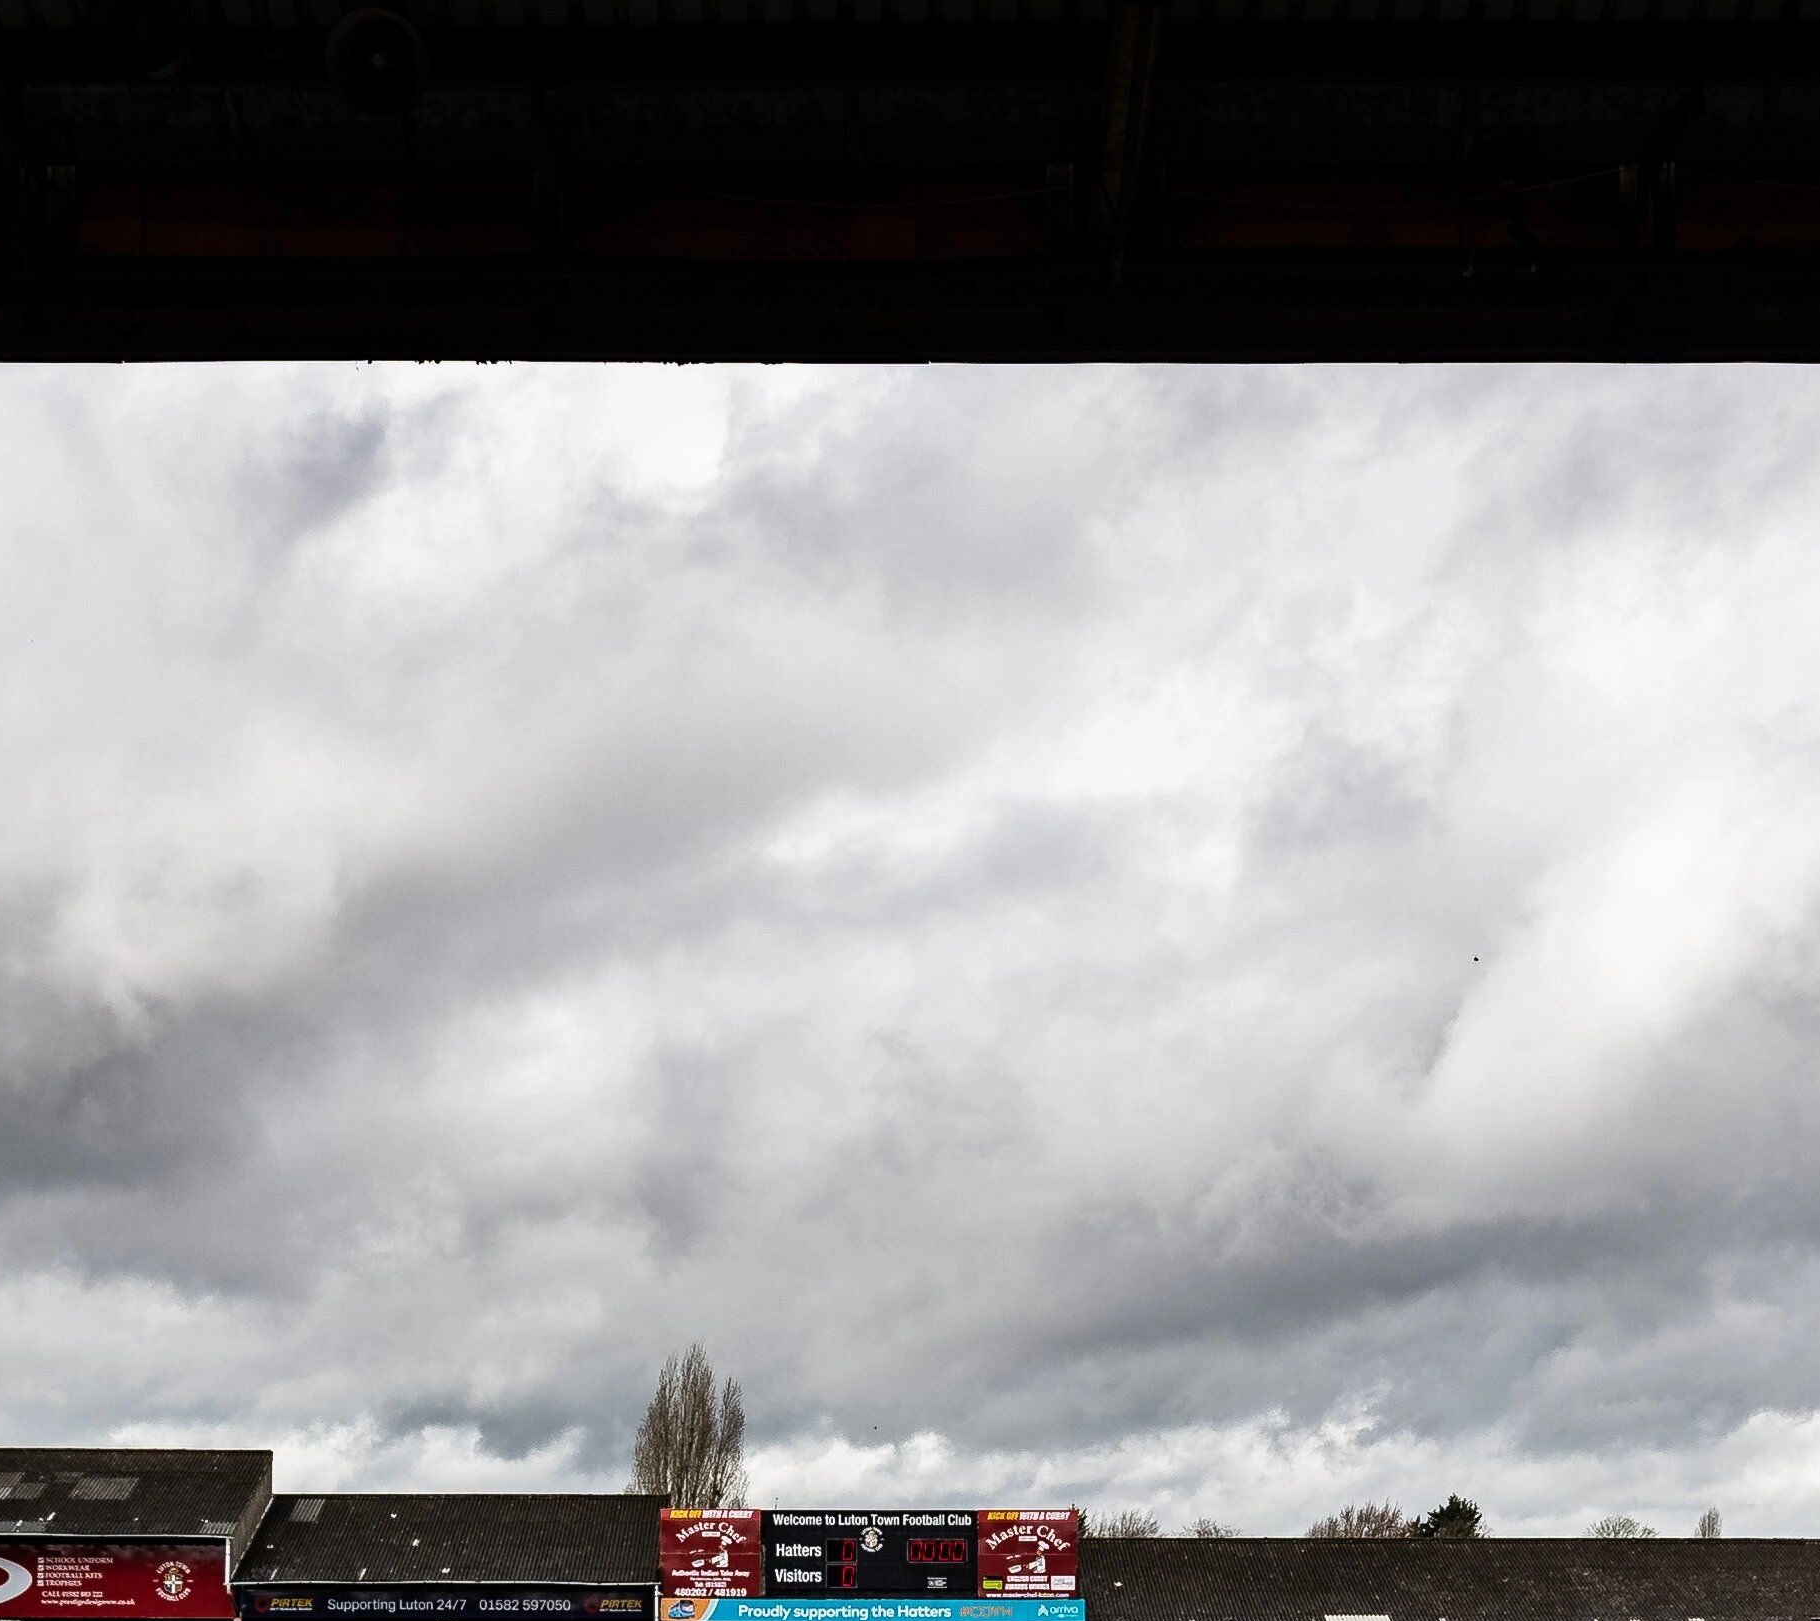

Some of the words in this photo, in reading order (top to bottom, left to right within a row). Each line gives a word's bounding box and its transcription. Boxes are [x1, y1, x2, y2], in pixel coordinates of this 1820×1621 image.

[773, 1514, 822, 1525] Welcome
[825, 1515, 835, 1525] to
[838, 1514, 867, 1525] Luton
[871, 1514, 900, 1525] Town
[903, 1514, 945, 1525] Football
[948, 1514, 972, 1526] Club
[676, 1522, 716, 1543] Master
[719, 1522, 746, 1543] Chef
[985, 1525, 1033, 1550] Master
[1037, 1526, 1070, 1551] Chef
[776, 1544, 821, 1557] Hatters
[775, 1569, 822, 1582] Visitors
[271, 1599, 313, 1608] PIRTEK
[328, 1598, 396, 1612] Supporting
[400, 1598, 433, 1610] Luton
[437, 1599, 466, 1610] 24/7
[479, 1599, 519, 1611] 01582
[522, 1600, 571, 1611] 597050
[601, 1600, 641, 1608] PIRTEK
[738, 1604, 790, 1619] Proudly
[793, 1606, 867, 1620] supporting
[871, 1605, 894, 1617] the
[897, 1605, 951, 1617] Hatters
